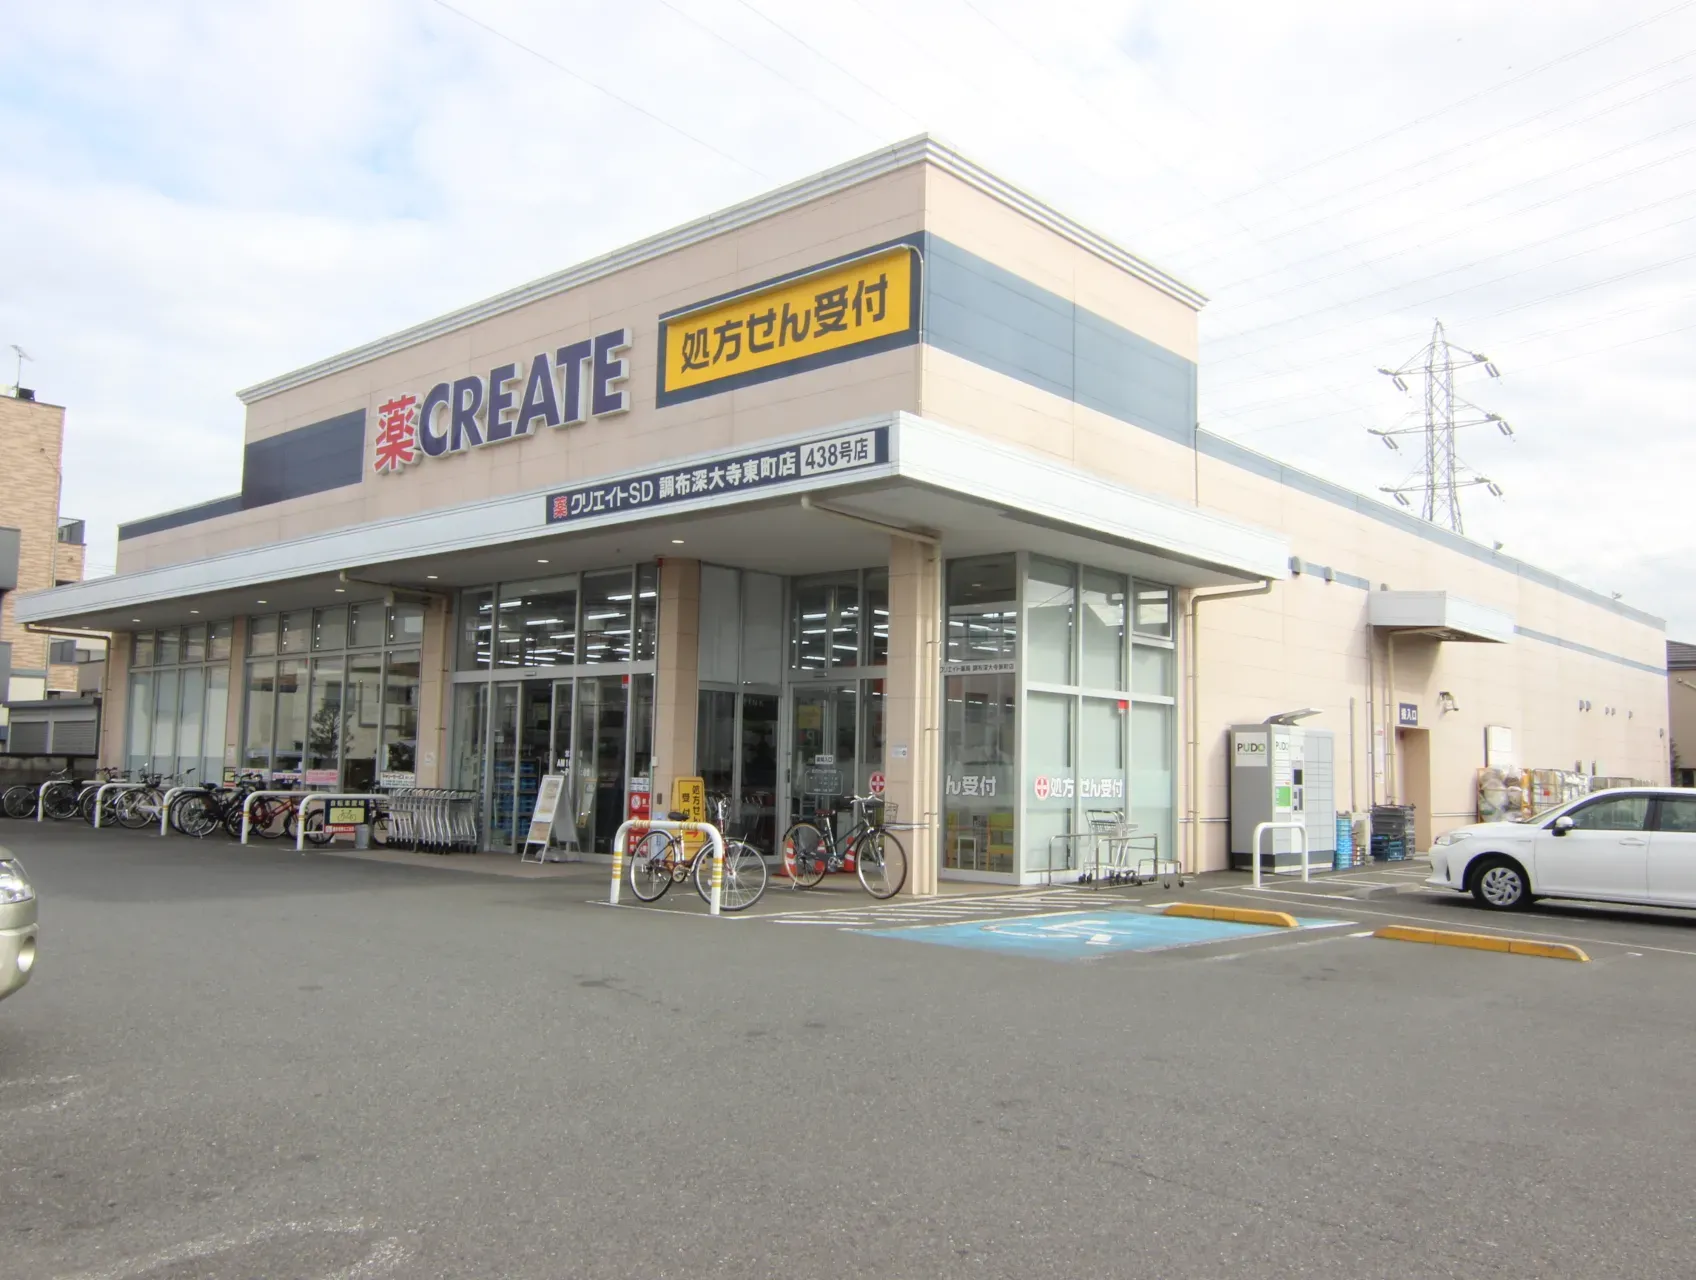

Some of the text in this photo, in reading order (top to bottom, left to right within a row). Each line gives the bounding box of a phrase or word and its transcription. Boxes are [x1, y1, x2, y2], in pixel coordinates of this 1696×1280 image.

[681, 273, 888, 374] 処方せん受付
[373, 327, 630, 474] 薬 CREATE
[553, 437, 869, 518] 薬 クリエイトSD 調布深大寺東町店 438号店
[1050, 777, 1123, 798] 処方せん受付
[1237, 742, 1266, 752] PUDO
